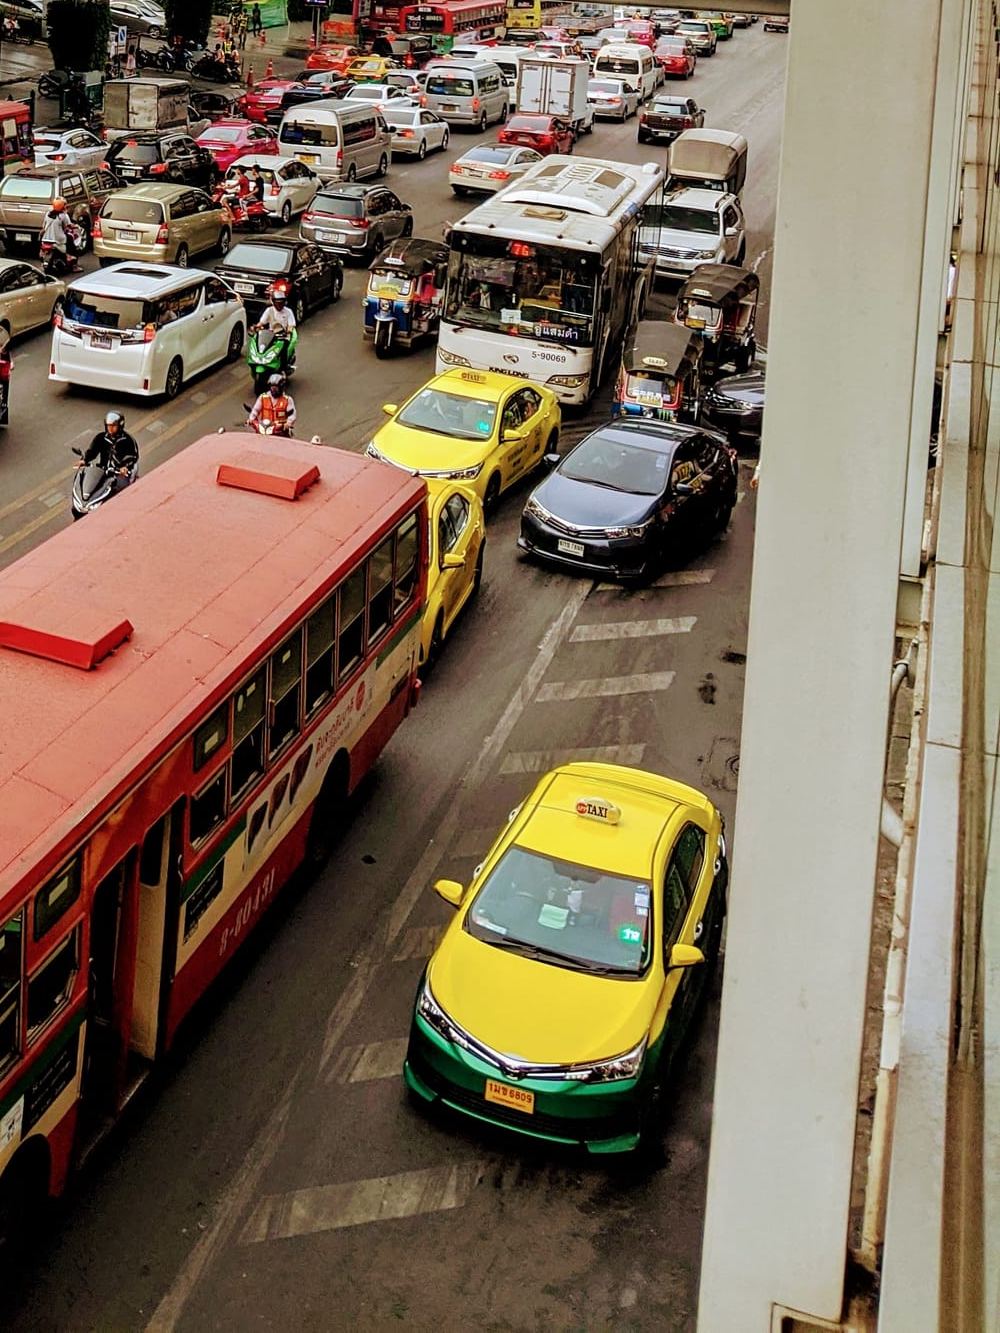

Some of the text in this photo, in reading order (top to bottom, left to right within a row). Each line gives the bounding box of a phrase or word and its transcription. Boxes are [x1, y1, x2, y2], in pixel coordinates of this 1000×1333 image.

[512, 243, 530, 257] 76
[534, 323, 579, 340] อู่แสมดำ
[531, 350, 567, 364] 5-90069
[587, 803, 608, 818] TAXI
